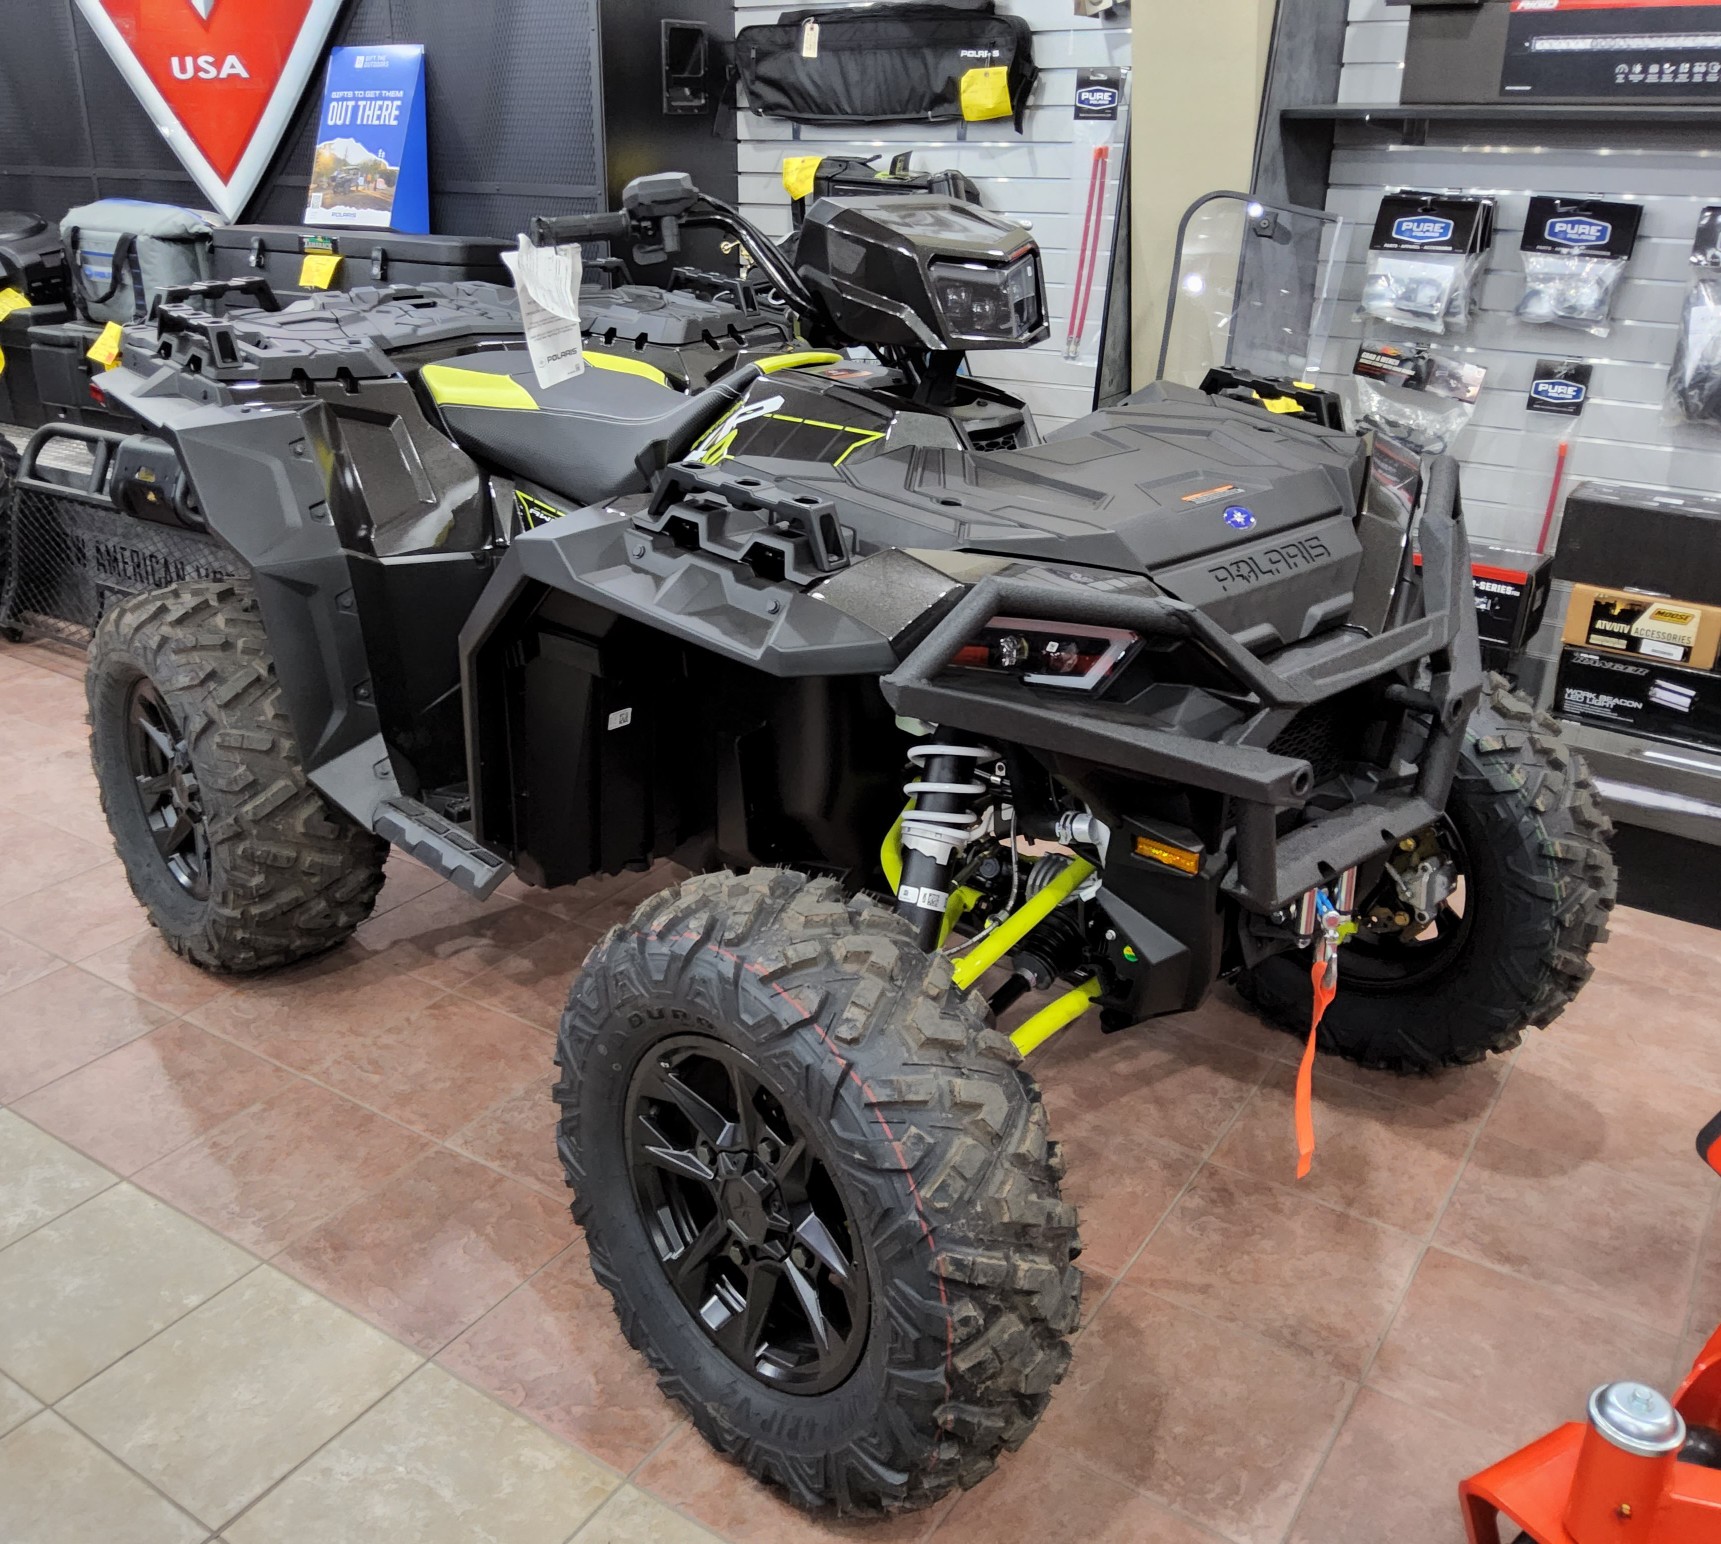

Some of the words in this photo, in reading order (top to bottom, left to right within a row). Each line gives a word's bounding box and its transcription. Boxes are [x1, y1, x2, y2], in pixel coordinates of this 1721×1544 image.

[171, 54, 250, 80] USA
[382, 90, 404, 98] THEM
[1081, 92, 1112, 101] PURE
[327, 101, 355, 126] OUT
[356, 100, 402, 126] THERE
[1401, 221, 1446, 233] PURE
[1554, 222, 1602, 236] PURE
[546, 347, 578, 364] POLARIS
[1537, 383, 1578, 396] PURE
[95, 542, 186, 587] AMERICAN
[1208, 536, 1331, 592] POLARIS
[1654, 609, 1691, 622] MOOSE
[1595, 619, 1630, 634] ATV/UTV
[1633, 627, 1692, 645] ACCESSORIES
[1564, 693, 1584, 703] LED
[1586, 697, 1616, 710] LIGHT
[1565, 687, 1598, 699] WORK
[1599, 694, 1643, 710] BEACON
